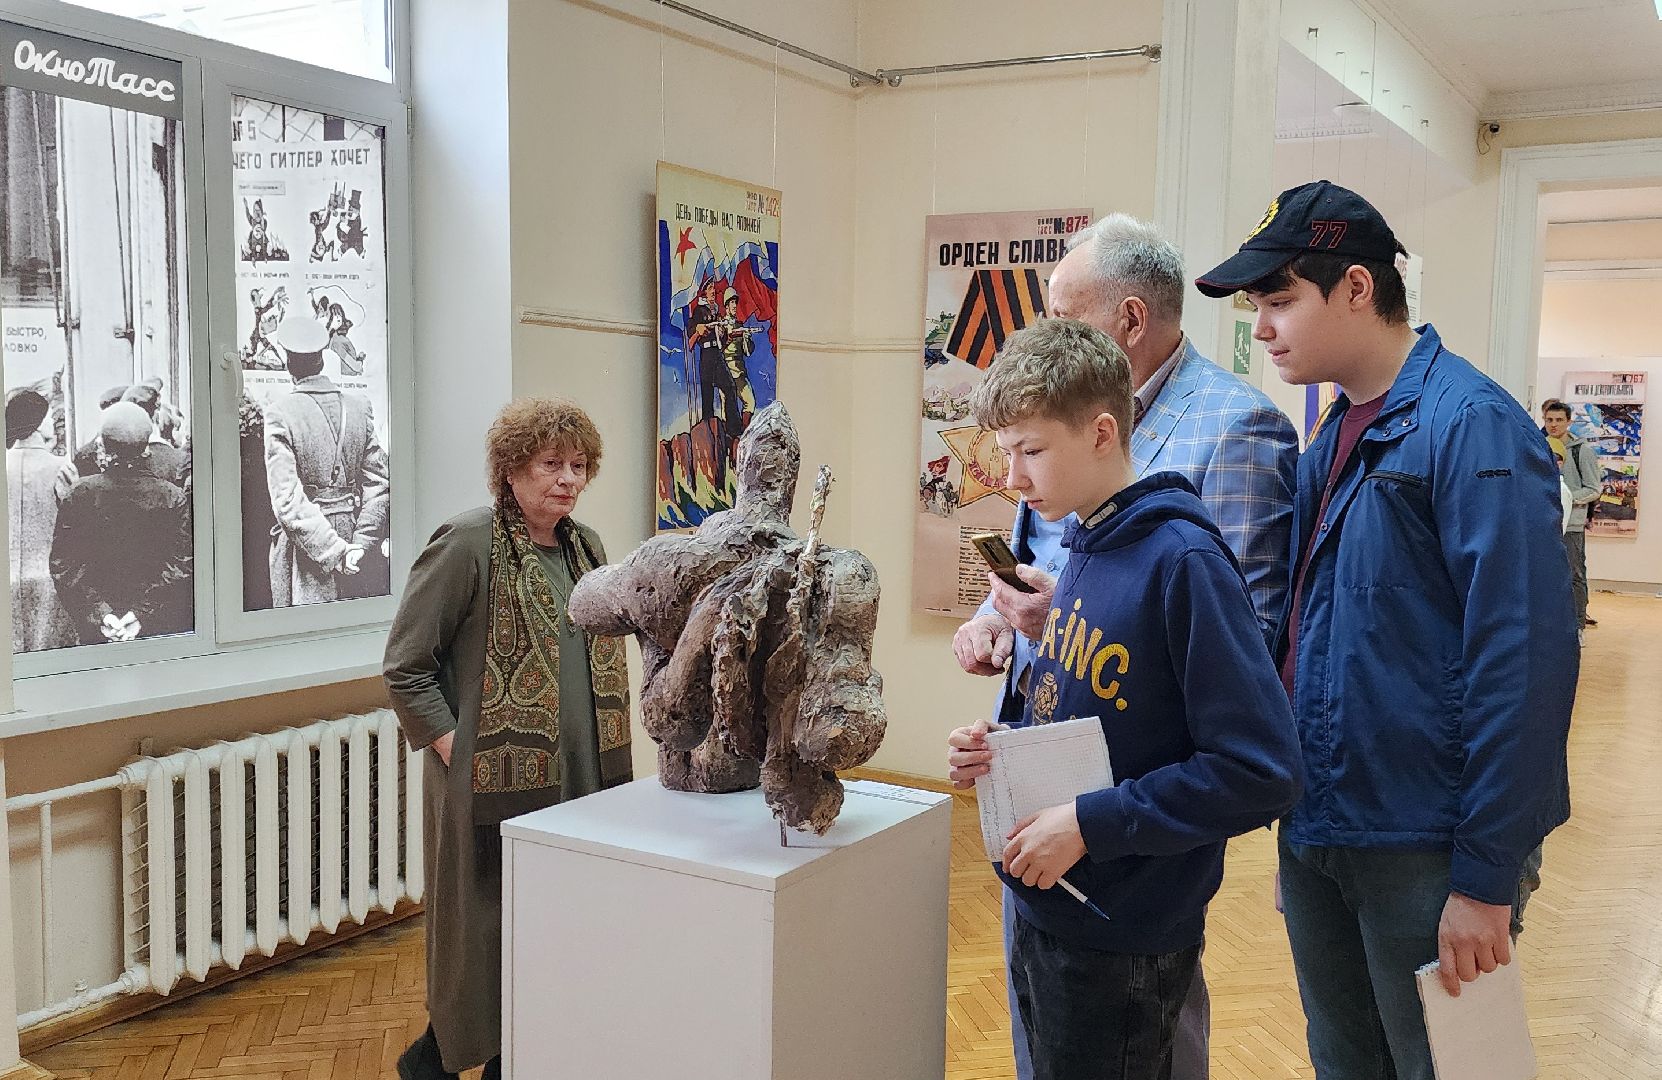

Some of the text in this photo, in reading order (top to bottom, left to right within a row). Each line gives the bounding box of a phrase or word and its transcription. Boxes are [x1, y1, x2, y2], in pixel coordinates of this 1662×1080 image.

[270, 150, 323, 169] ГИТЛЕР
[330, 147, 371, 167] ХОЧЕТ
[675, 202, 692, 222] ДЕНЬ
[694, 206, 719, 228] ПОБЕДЫ
[721, 211, 734, 232] НАД
[1309, 220, 1349, 249] 77
[939, 241, 1000, 268] ОРДЕН
